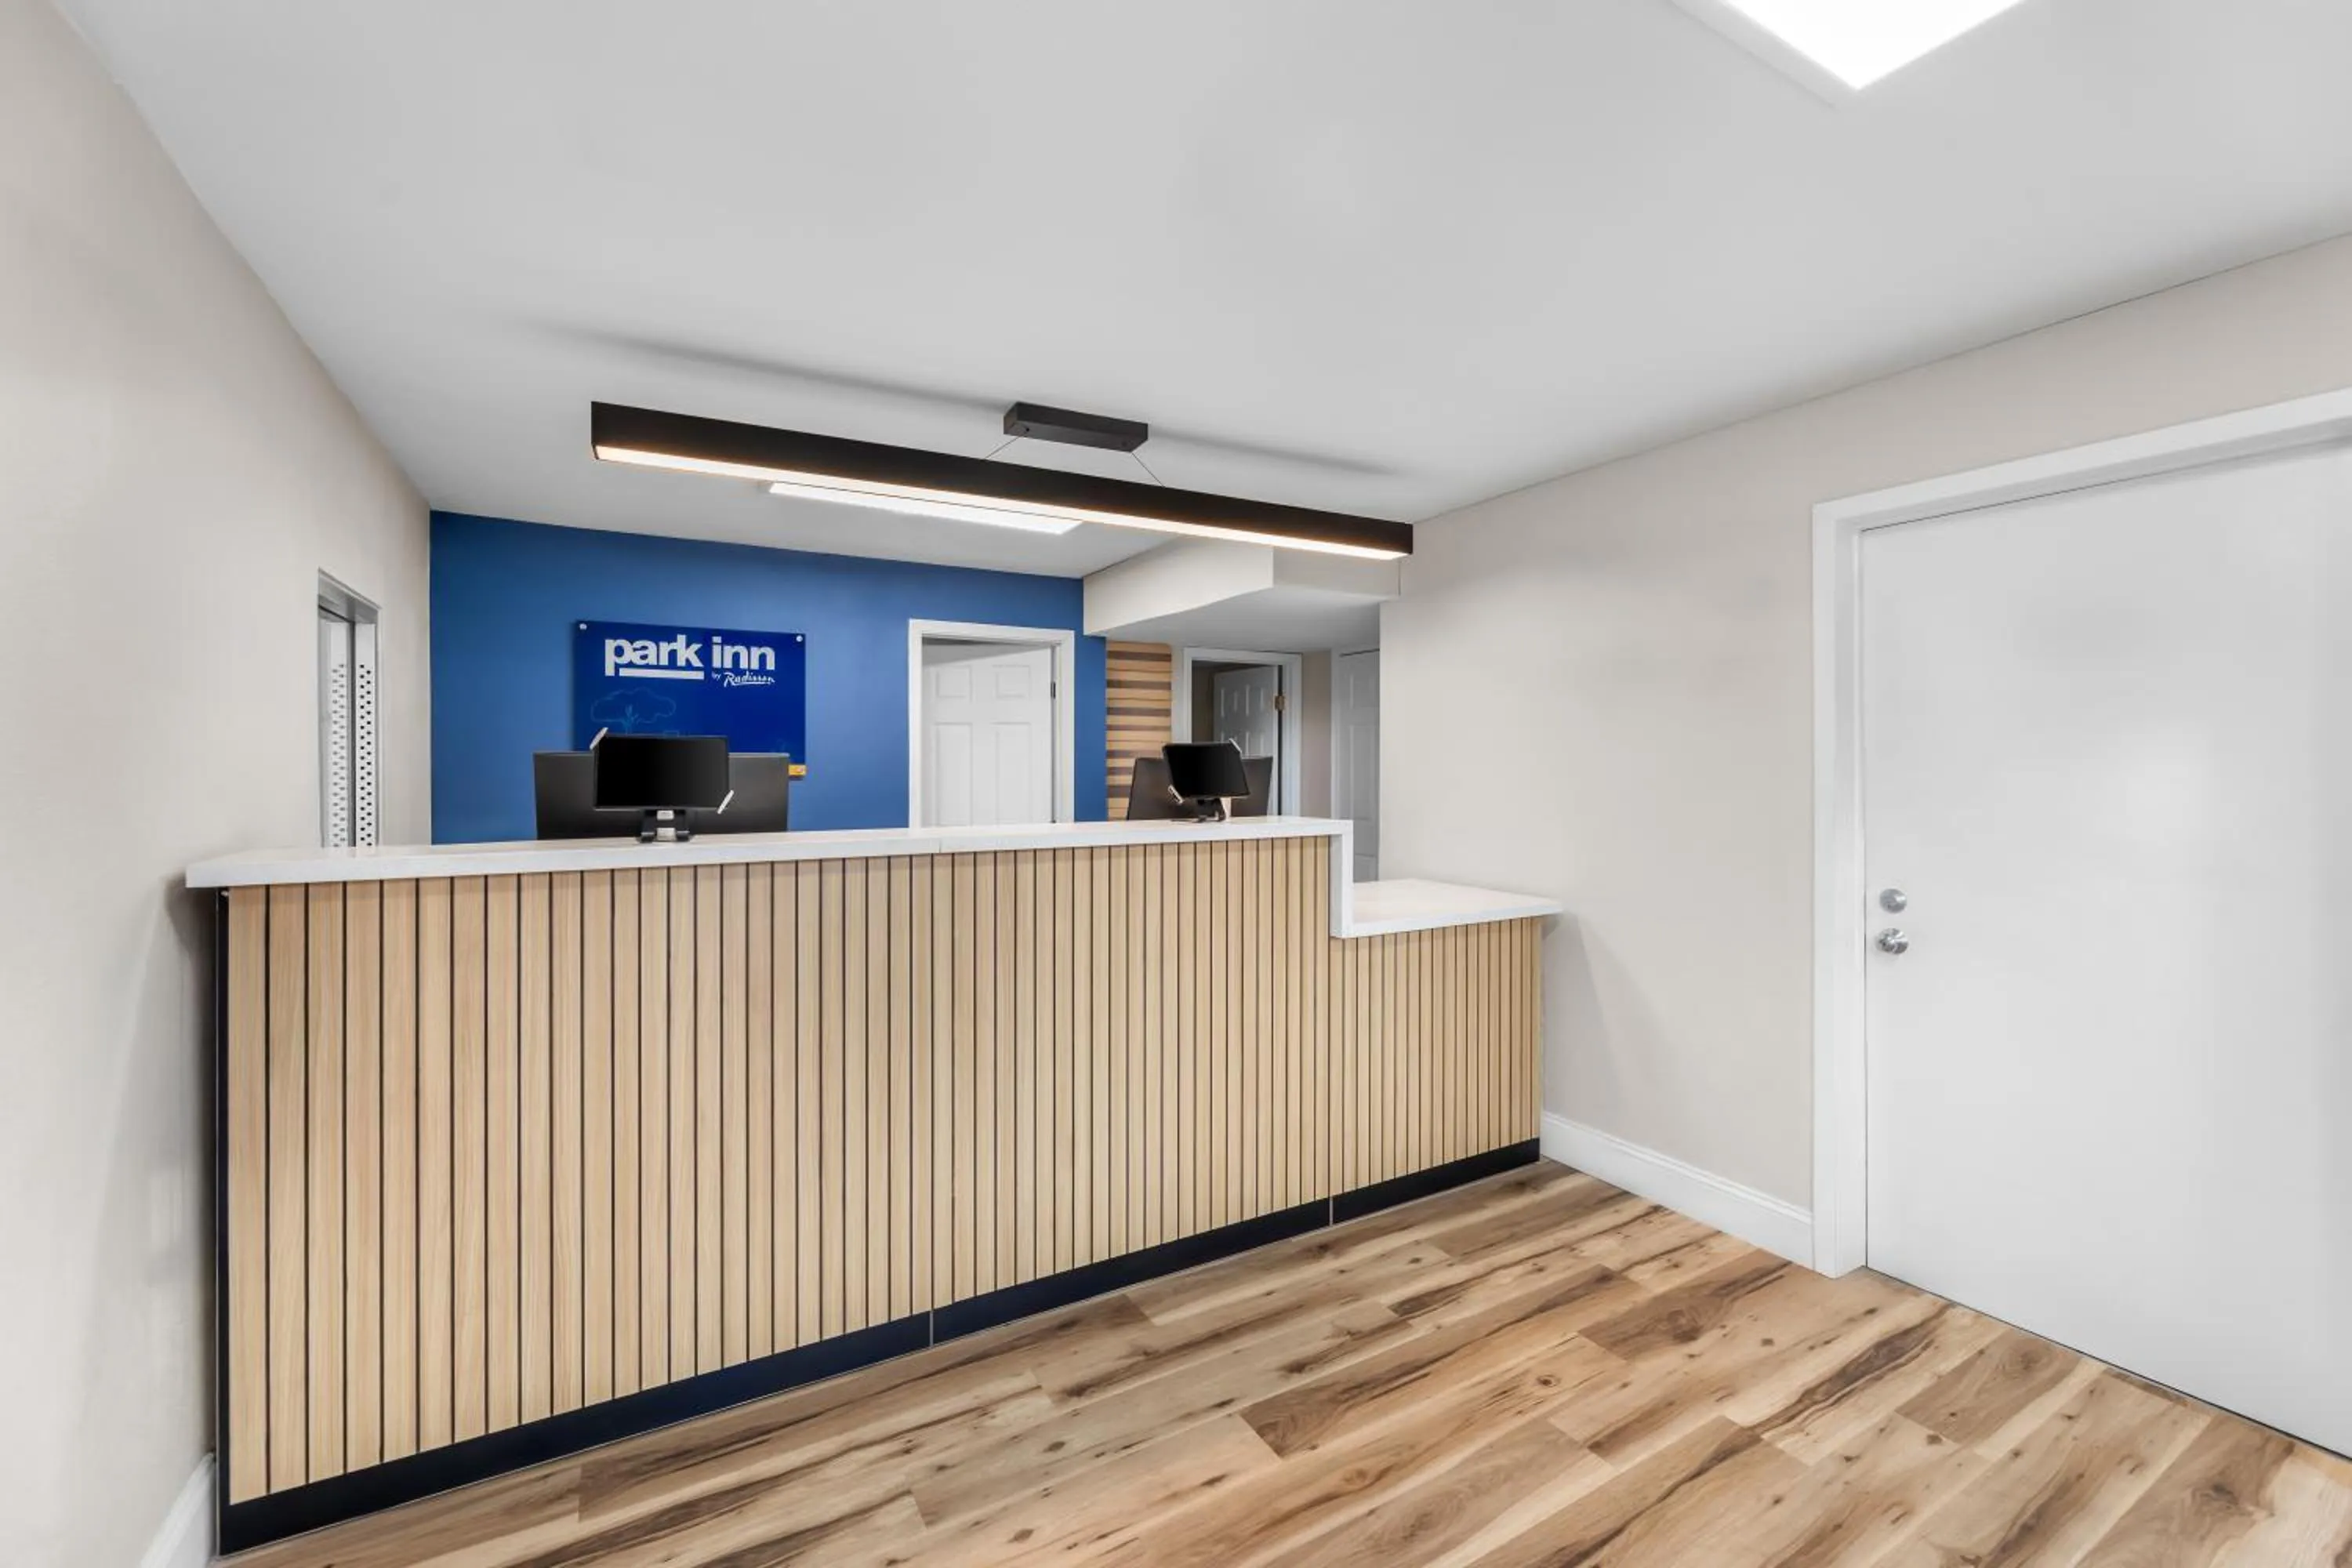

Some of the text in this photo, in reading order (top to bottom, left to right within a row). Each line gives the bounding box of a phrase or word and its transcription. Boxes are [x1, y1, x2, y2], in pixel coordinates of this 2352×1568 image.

[604, 634, 775, 677] park inn
[711, 669, 775, 688] by Radisson
